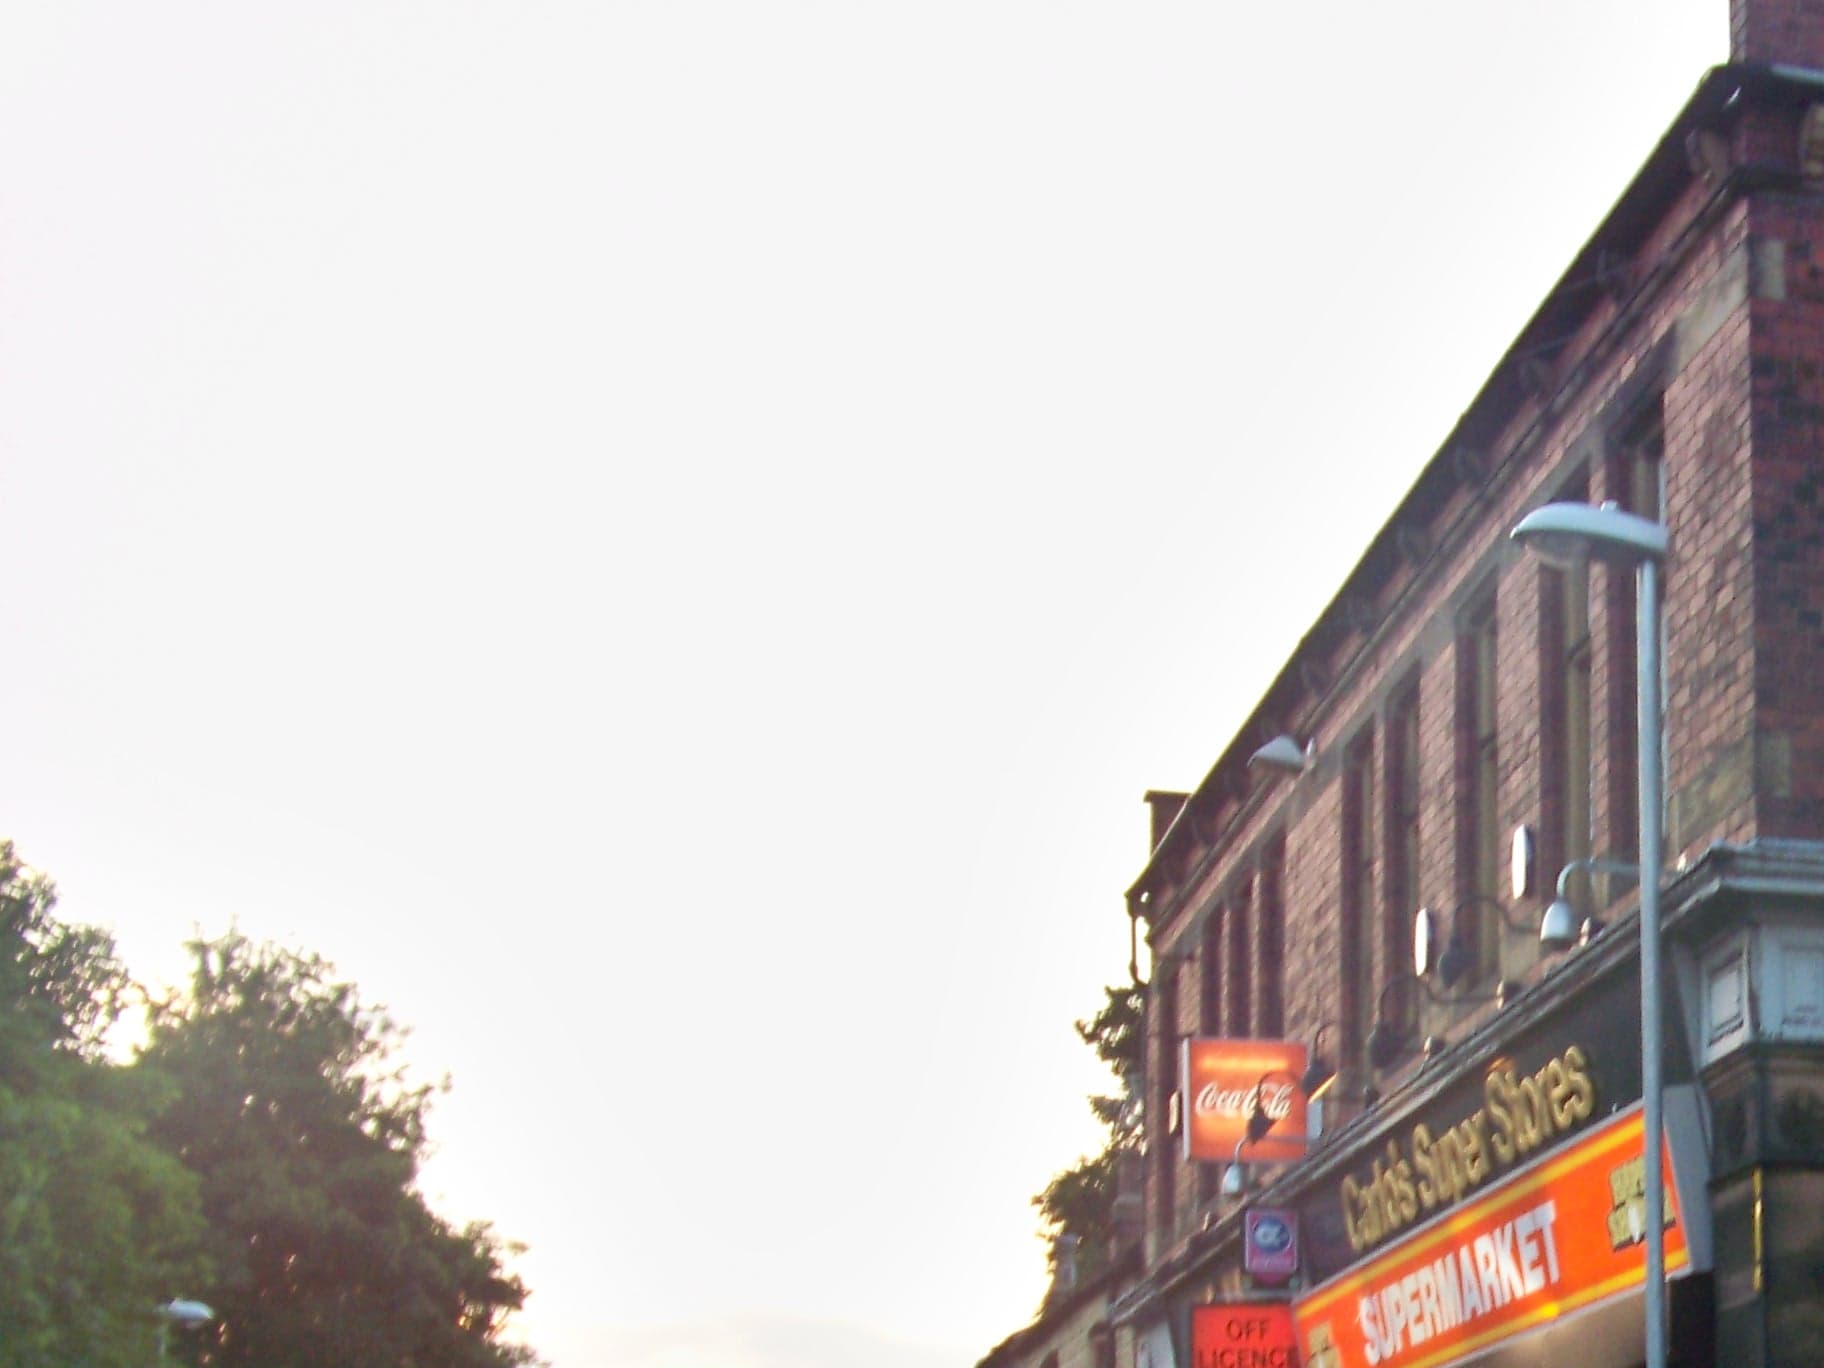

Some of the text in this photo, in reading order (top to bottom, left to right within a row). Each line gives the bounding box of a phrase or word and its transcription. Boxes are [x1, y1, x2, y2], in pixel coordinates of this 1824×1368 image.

[1411, 1108, 1491, 1209] Super
[1485, 1044, 1596, 1165] Stores
[1225, 1318, 1271, 1342] OFF
[1359, 1199, 1560, 1367] SUPERMARKET
